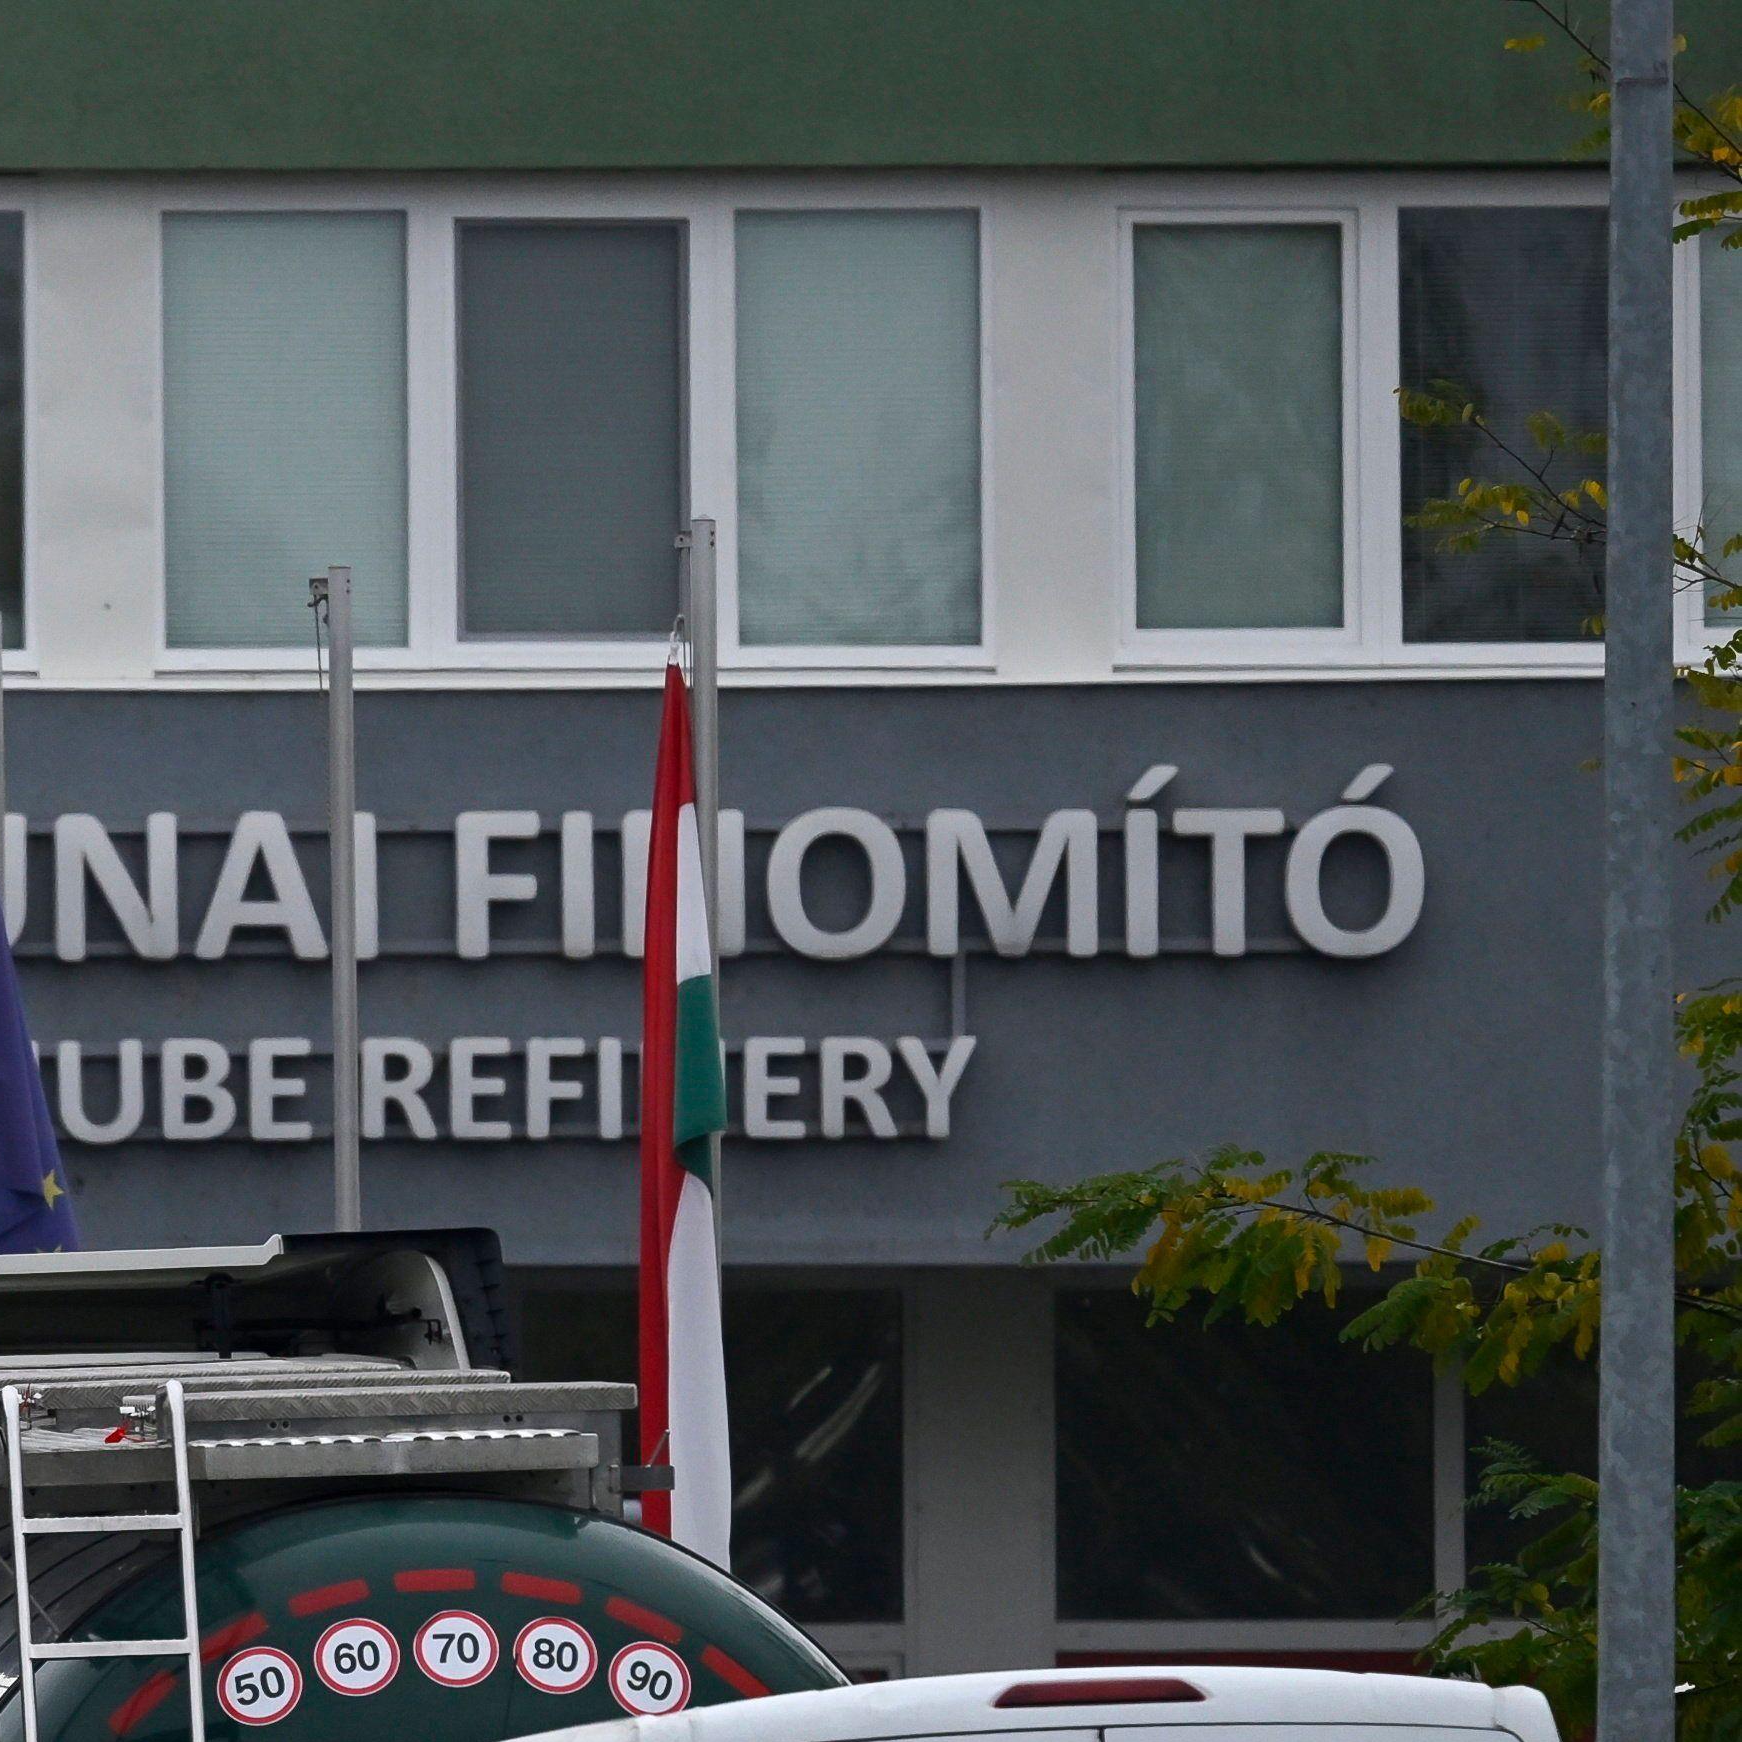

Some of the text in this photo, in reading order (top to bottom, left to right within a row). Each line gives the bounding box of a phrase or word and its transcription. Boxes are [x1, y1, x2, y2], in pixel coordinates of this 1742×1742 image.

[358, 1034, 978, 1140] REFIERY
[333, 1640, 381, 1675] 60
[432, 1632, 480, 1665] 70
[532, 1637, 579, 1674] 80
[234, 1665, 286, 1707] 50
[625, 1659, 674, 1702] 90
